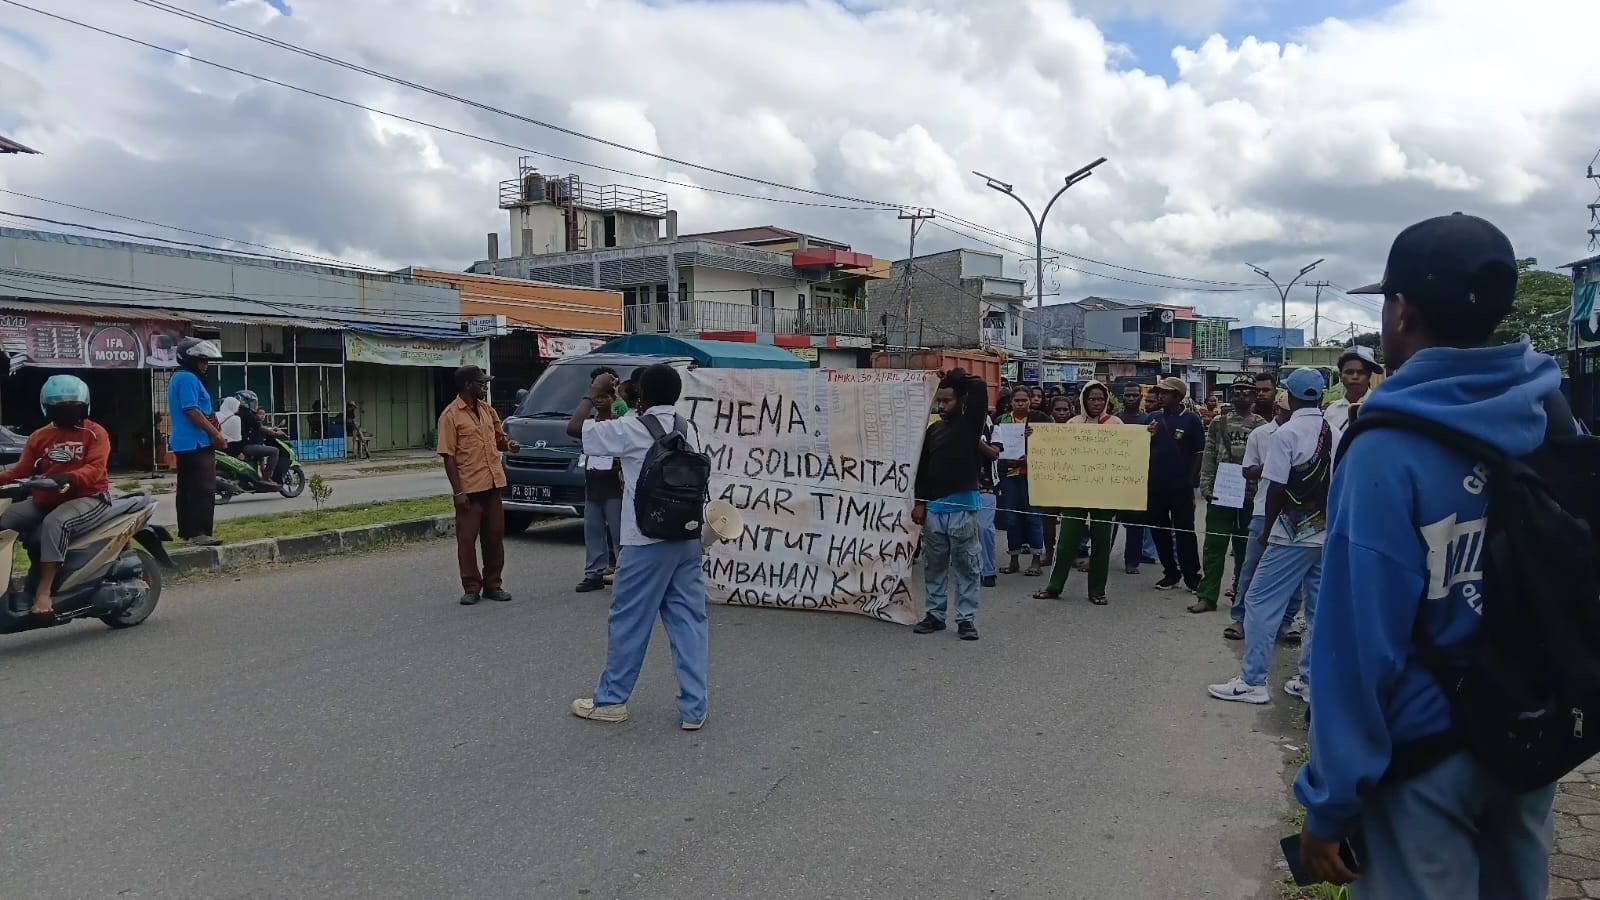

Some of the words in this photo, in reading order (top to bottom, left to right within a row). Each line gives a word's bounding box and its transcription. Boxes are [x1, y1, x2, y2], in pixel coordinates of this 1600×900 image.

[95, 351, 135, 361] MOTOR
[105, 338, 123, 349] IFA
[873, 372, 900, 384] APRIL
[744, 447, 911, 493] SOLIDARITAS
[810, 492, 909, 534] TIMIKA
[720, 524, 822, 555] NTUT
[701, 556, 819, 593] AMBAHAN
